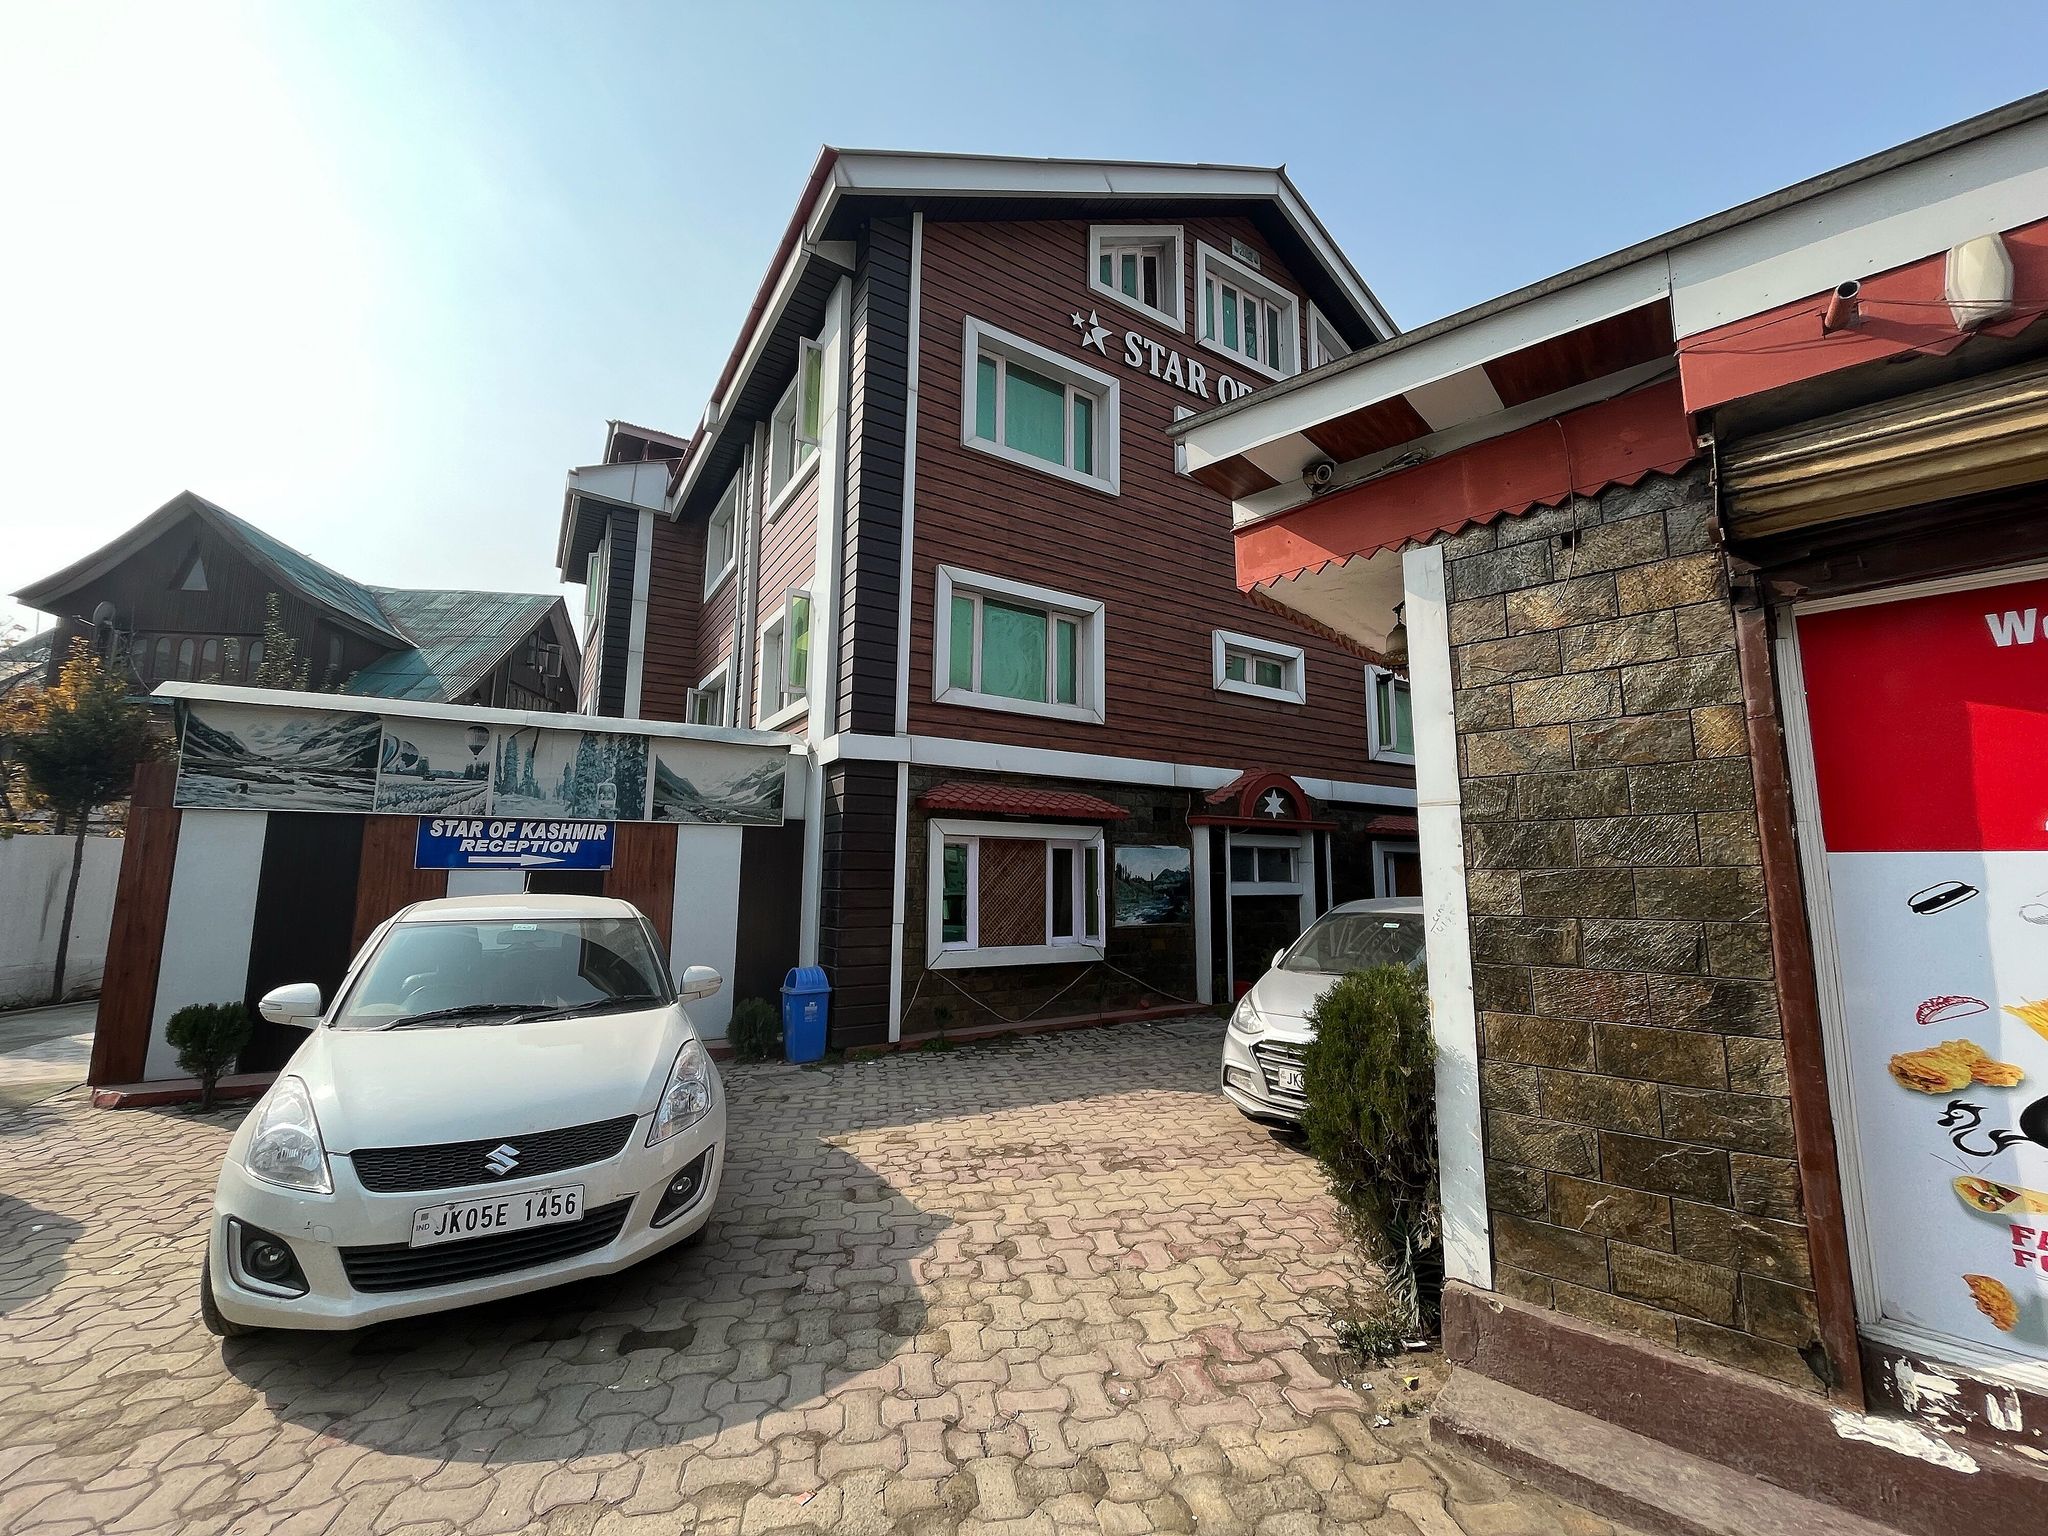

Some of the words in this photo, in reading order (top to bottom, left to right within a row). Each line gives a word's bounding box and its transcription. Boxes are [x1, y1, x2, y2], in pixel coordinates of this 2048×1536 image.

[1124, 331, 1209, 399] STAR
[1984, 607, 2048, 648] W
[430, 819, 484, 838] STAR
[489, 821, 517, 839] OF
[519, 822, 607, 840] KASHMIR
[459, 839, 579, 854] RECEPTION
[416, 1223, 430, 1232] IND
[434, 1203, 509, 1236] JK05E
[525, 1192, 576, 1222] 1456
